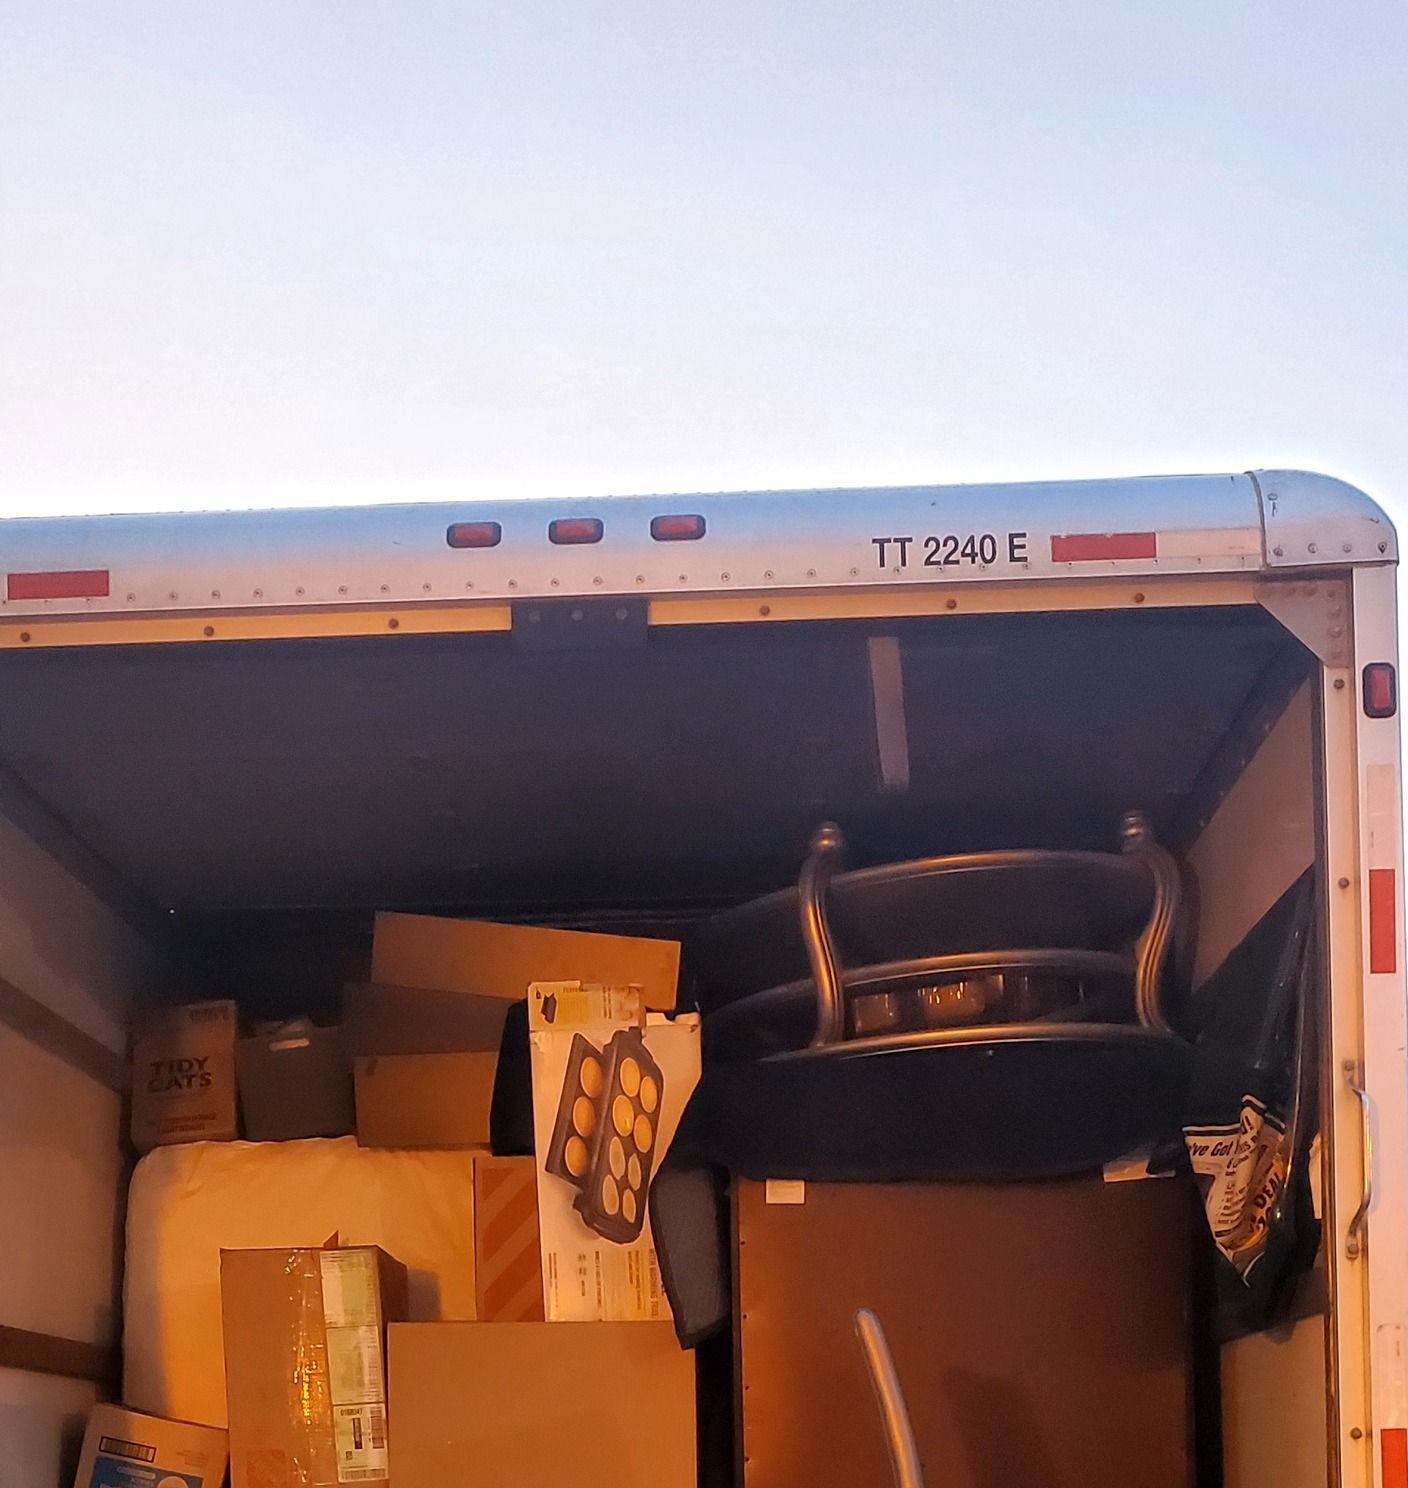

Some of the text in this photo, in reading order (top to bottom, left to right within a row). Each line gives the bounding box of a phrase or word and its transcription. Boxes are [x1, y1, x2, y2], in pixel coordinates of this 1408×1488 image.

[871, 532, 1028, 568] TT 2240 E
[150, 1056, 209, 1076] TIDY
[147, 1072, 212, 1092] CATS
